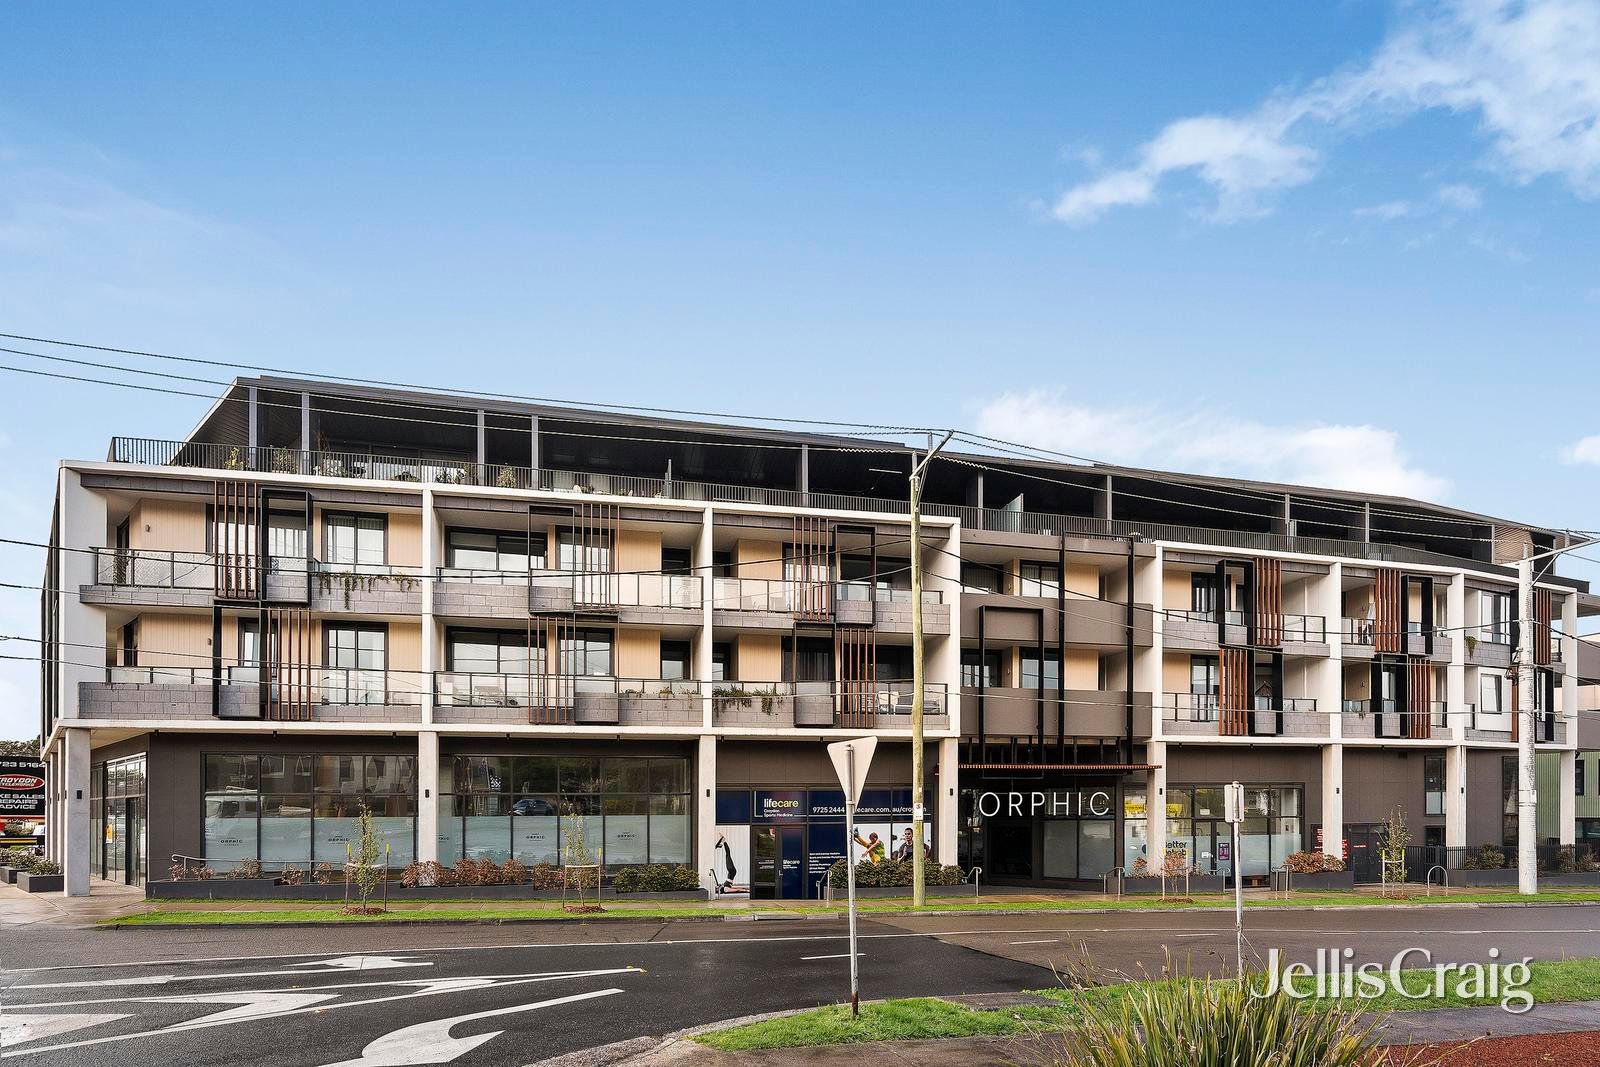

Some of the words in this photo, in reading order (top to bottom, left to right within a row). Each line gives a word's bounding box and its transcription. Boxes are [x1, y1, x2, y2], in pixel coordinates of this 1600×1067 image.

[763, 798, 799, 808] lifecare
[978, 791, 1110, 817] ORPHIC
[812, 806, 828, 814] 9725
[828, 805, 845, 813] 2444
[1165, 841, 1187, 849] etter
